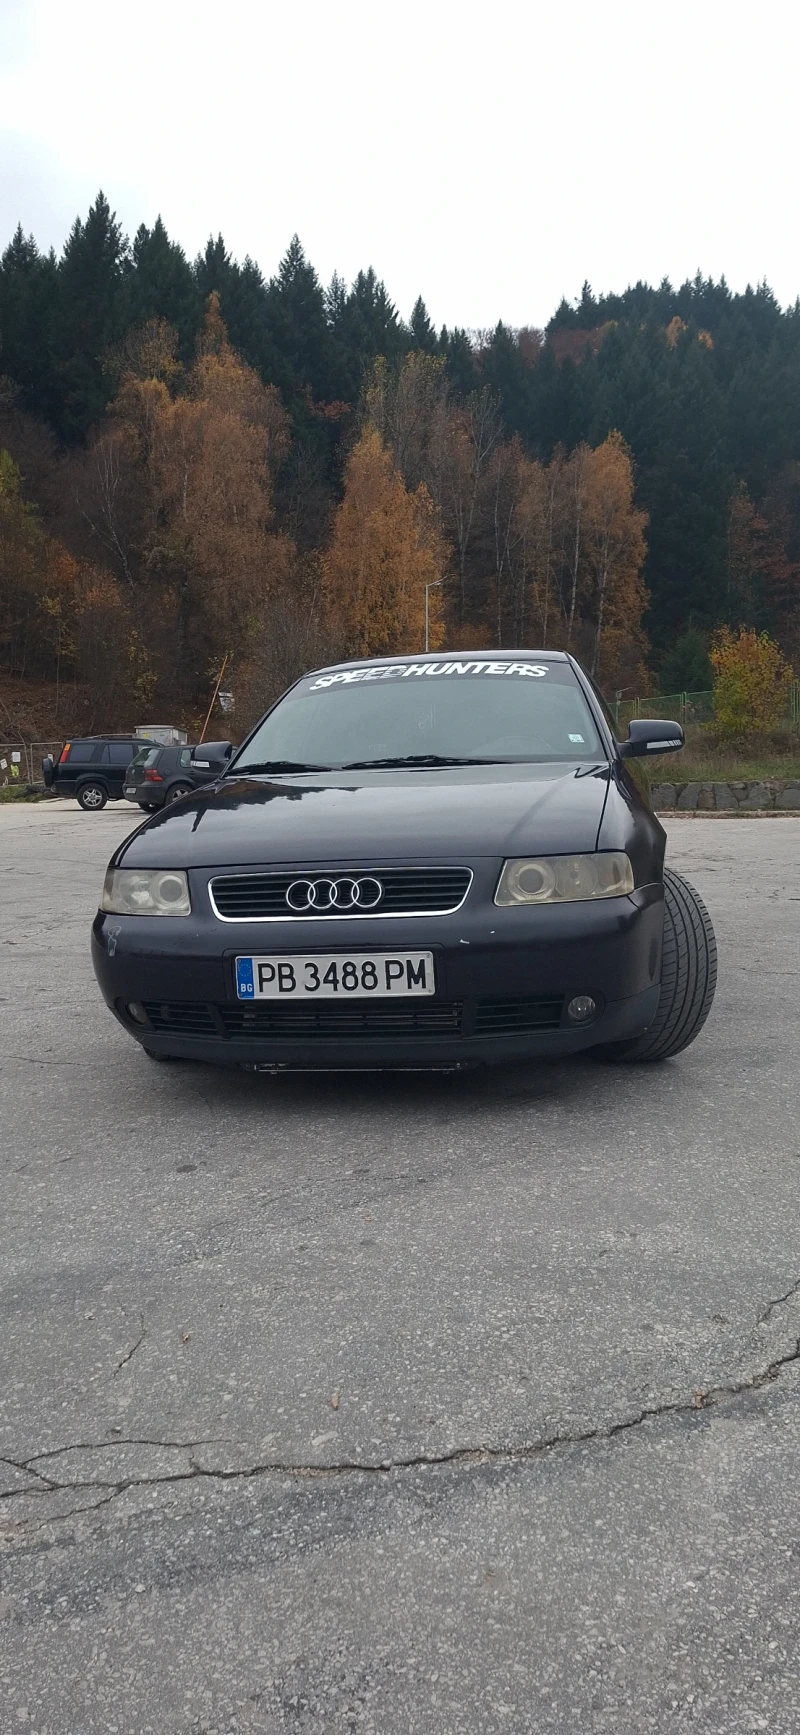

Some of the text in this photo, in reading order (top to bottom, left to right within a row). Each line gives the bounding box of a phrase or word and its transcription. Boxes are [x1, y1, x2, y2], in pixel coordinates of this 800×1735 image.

[309, 661, 550, 691] SPEEDHUNTERS
[240, 983, 253, 993] BG
[257, 958, 427, 993] PB 3488 PM
